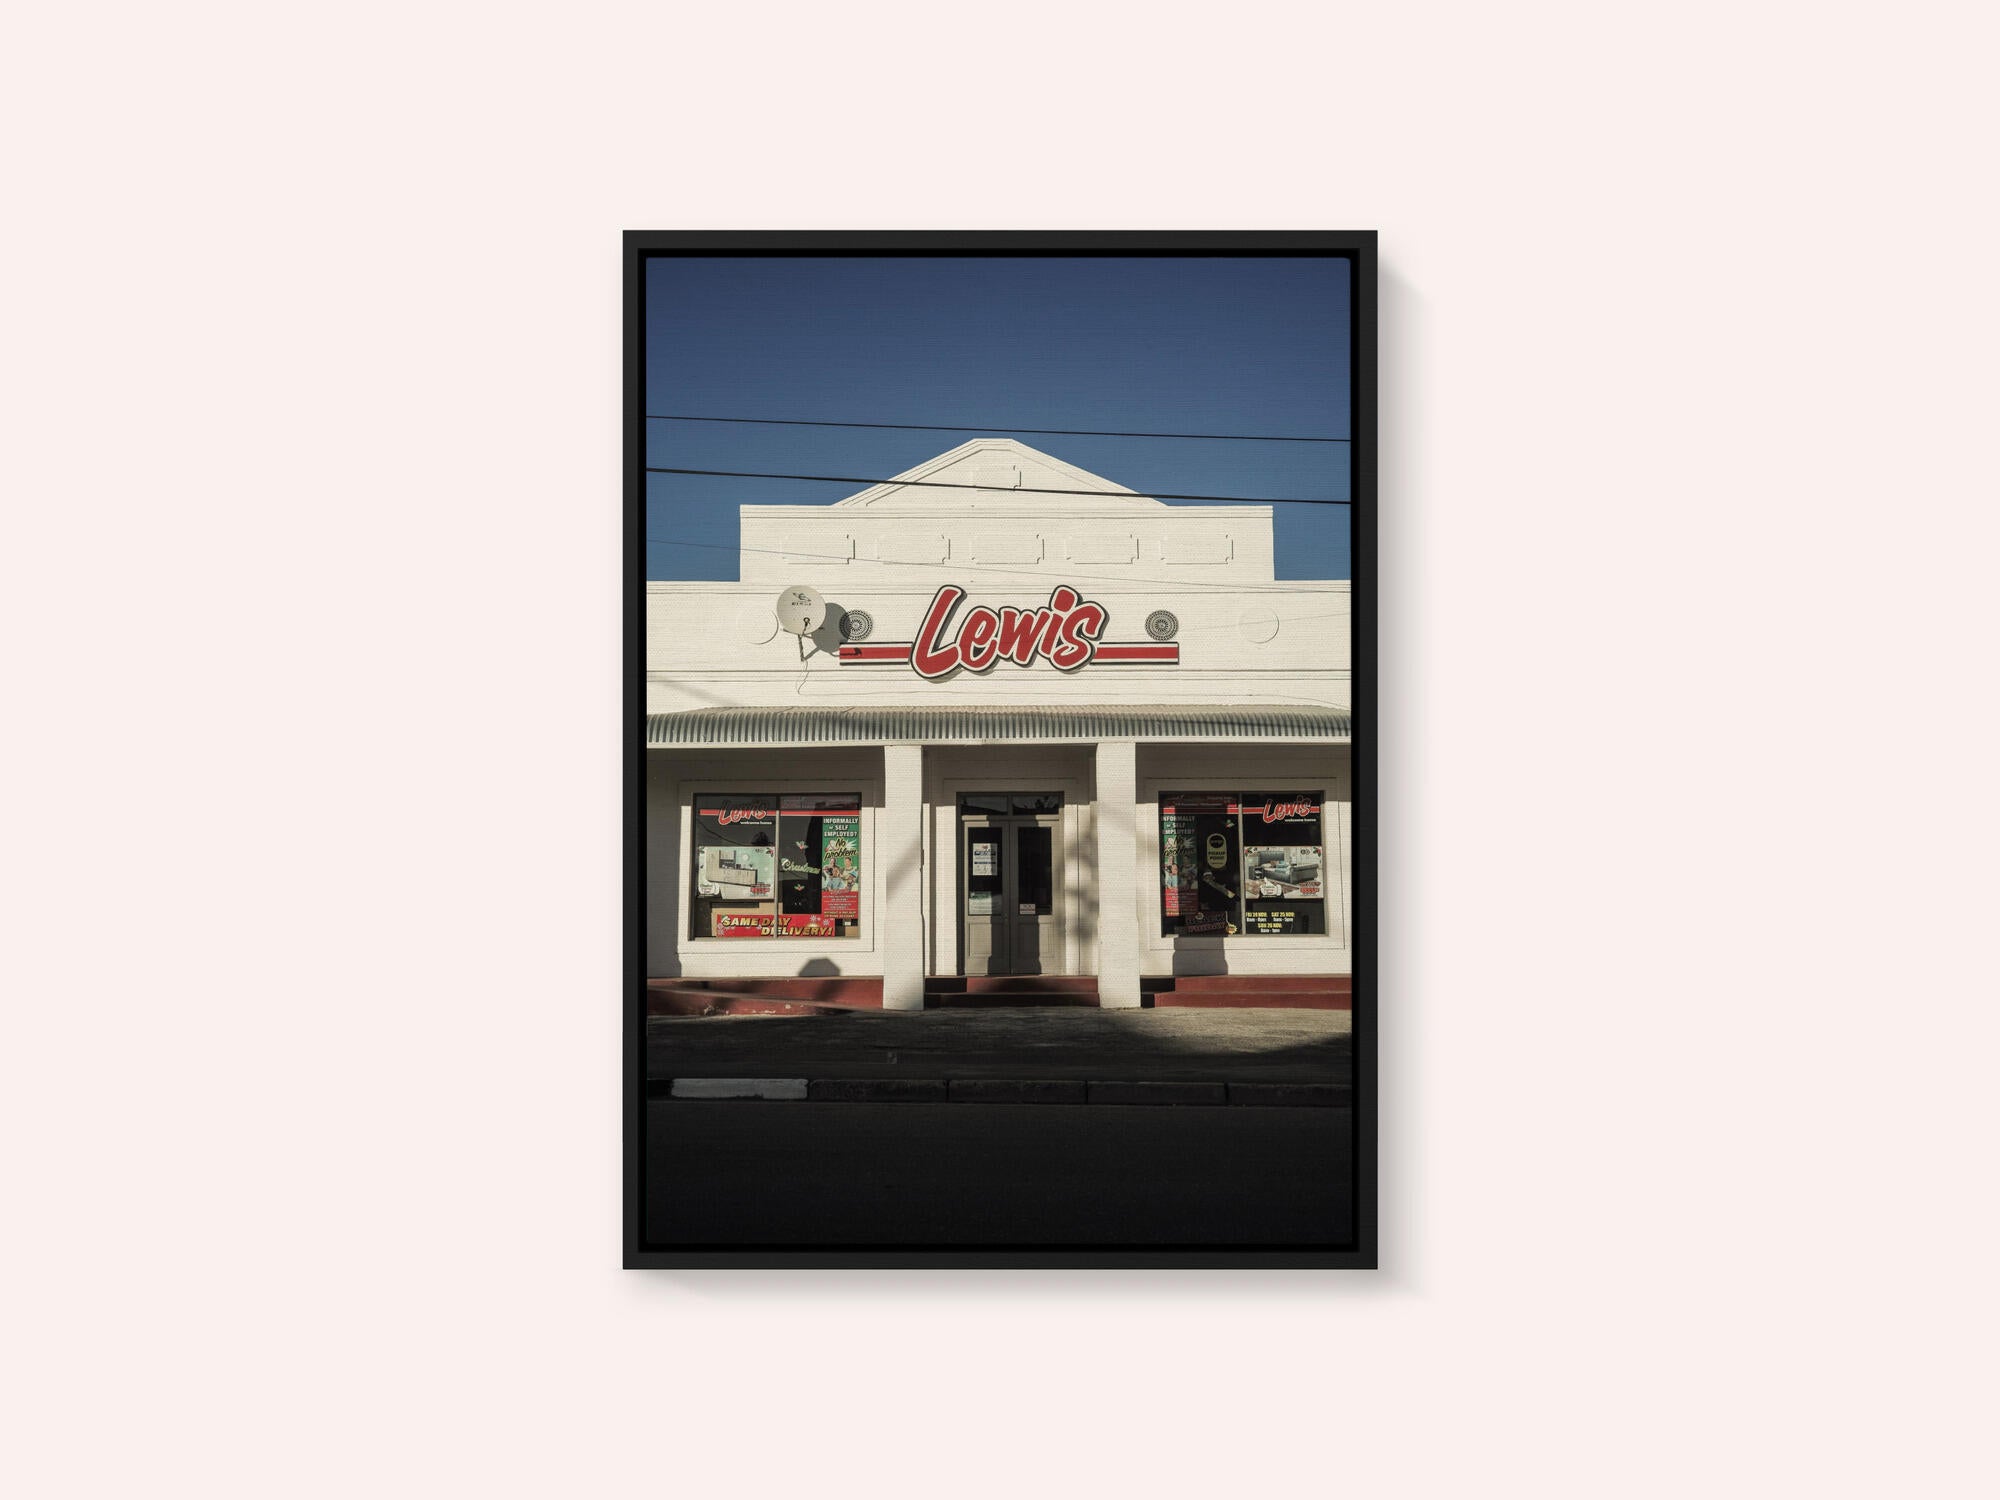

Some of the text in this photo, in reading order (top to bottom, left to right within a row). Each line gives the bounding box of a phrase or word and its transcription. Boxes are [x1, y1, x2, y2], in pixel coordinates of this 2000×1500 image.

[911, 585, 1109, 679] Lewis
[718, 800, 769, 826] Lewis
[1263, 795, 1312, 824] Lewis
[835, 838, 846, 848] No
[824, 847, 857, 861] problem
[722, 916, 791, 927] SAME DAY
[761, 926, 833, 936] DELIVERY!
